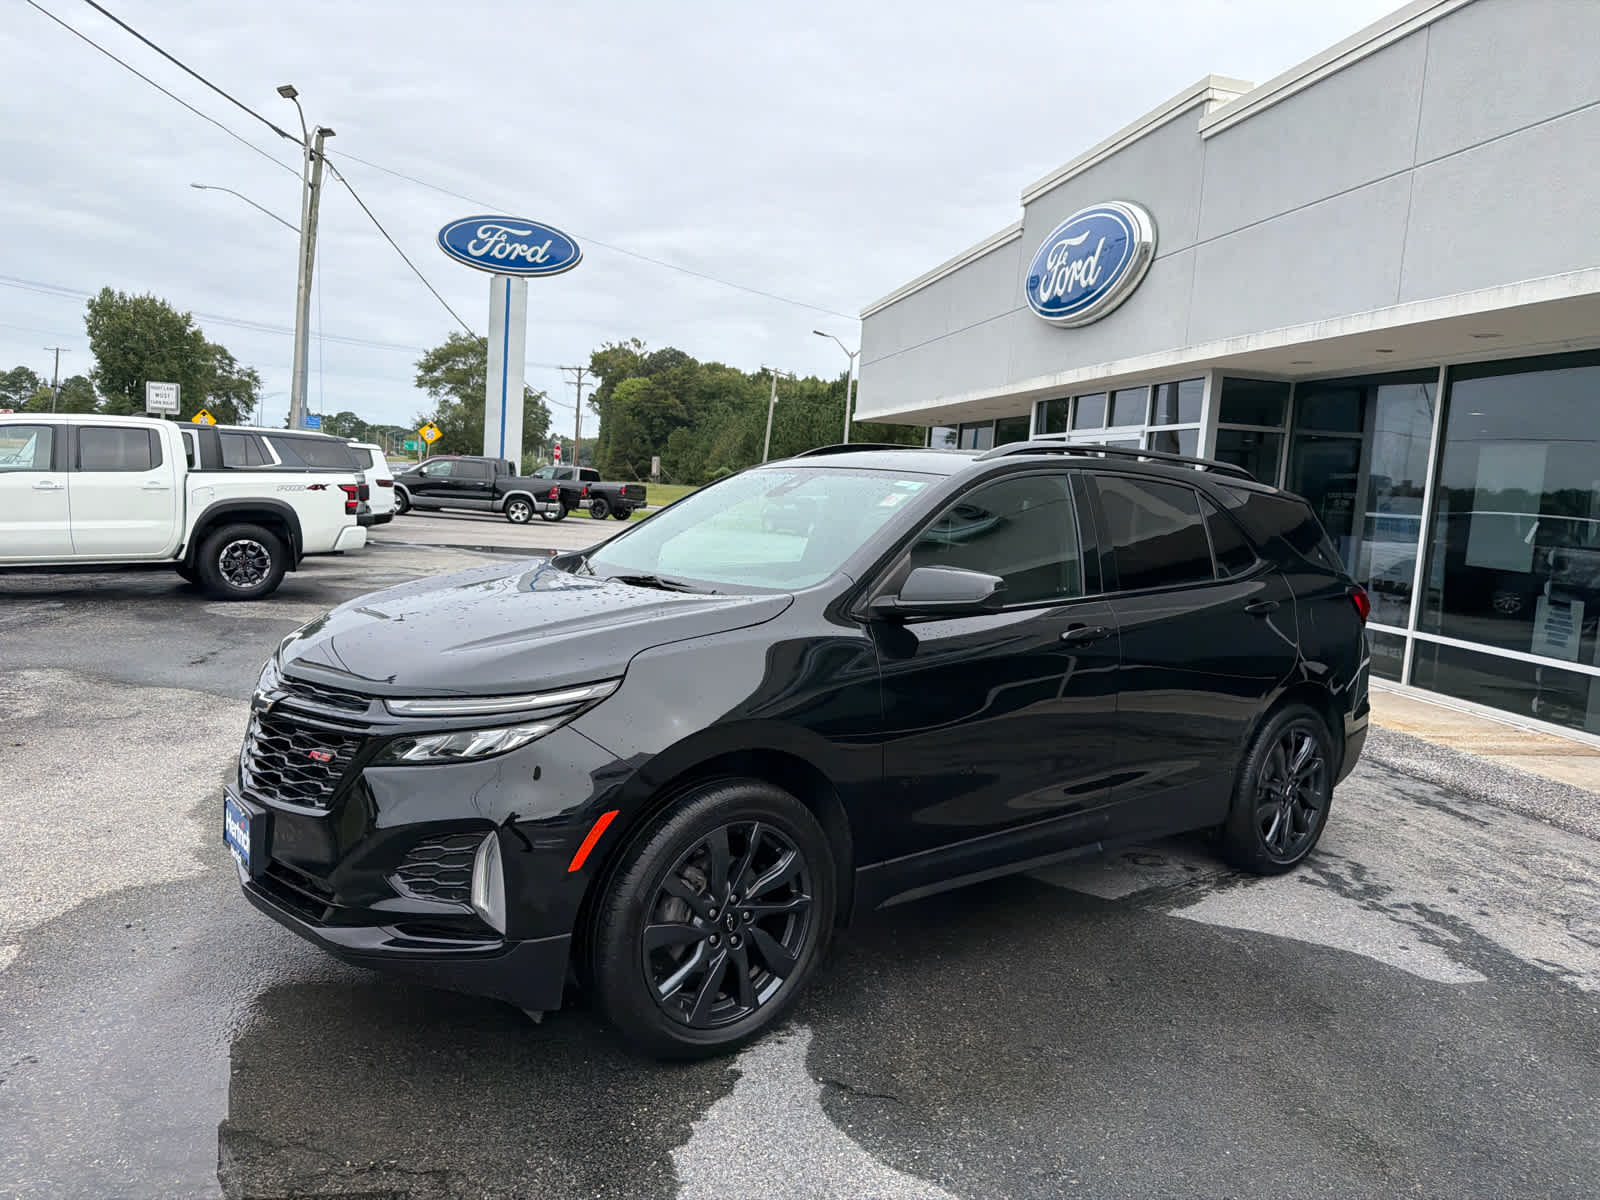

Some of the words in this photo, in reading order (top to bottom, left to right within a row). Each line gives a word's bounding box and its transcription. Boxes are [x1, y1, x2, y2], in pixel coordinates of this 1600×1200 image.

[467, 224, 552, 263] Ford
[1040, 230, 1106, 303] Ford
[308, 750, 330, 762] RS
